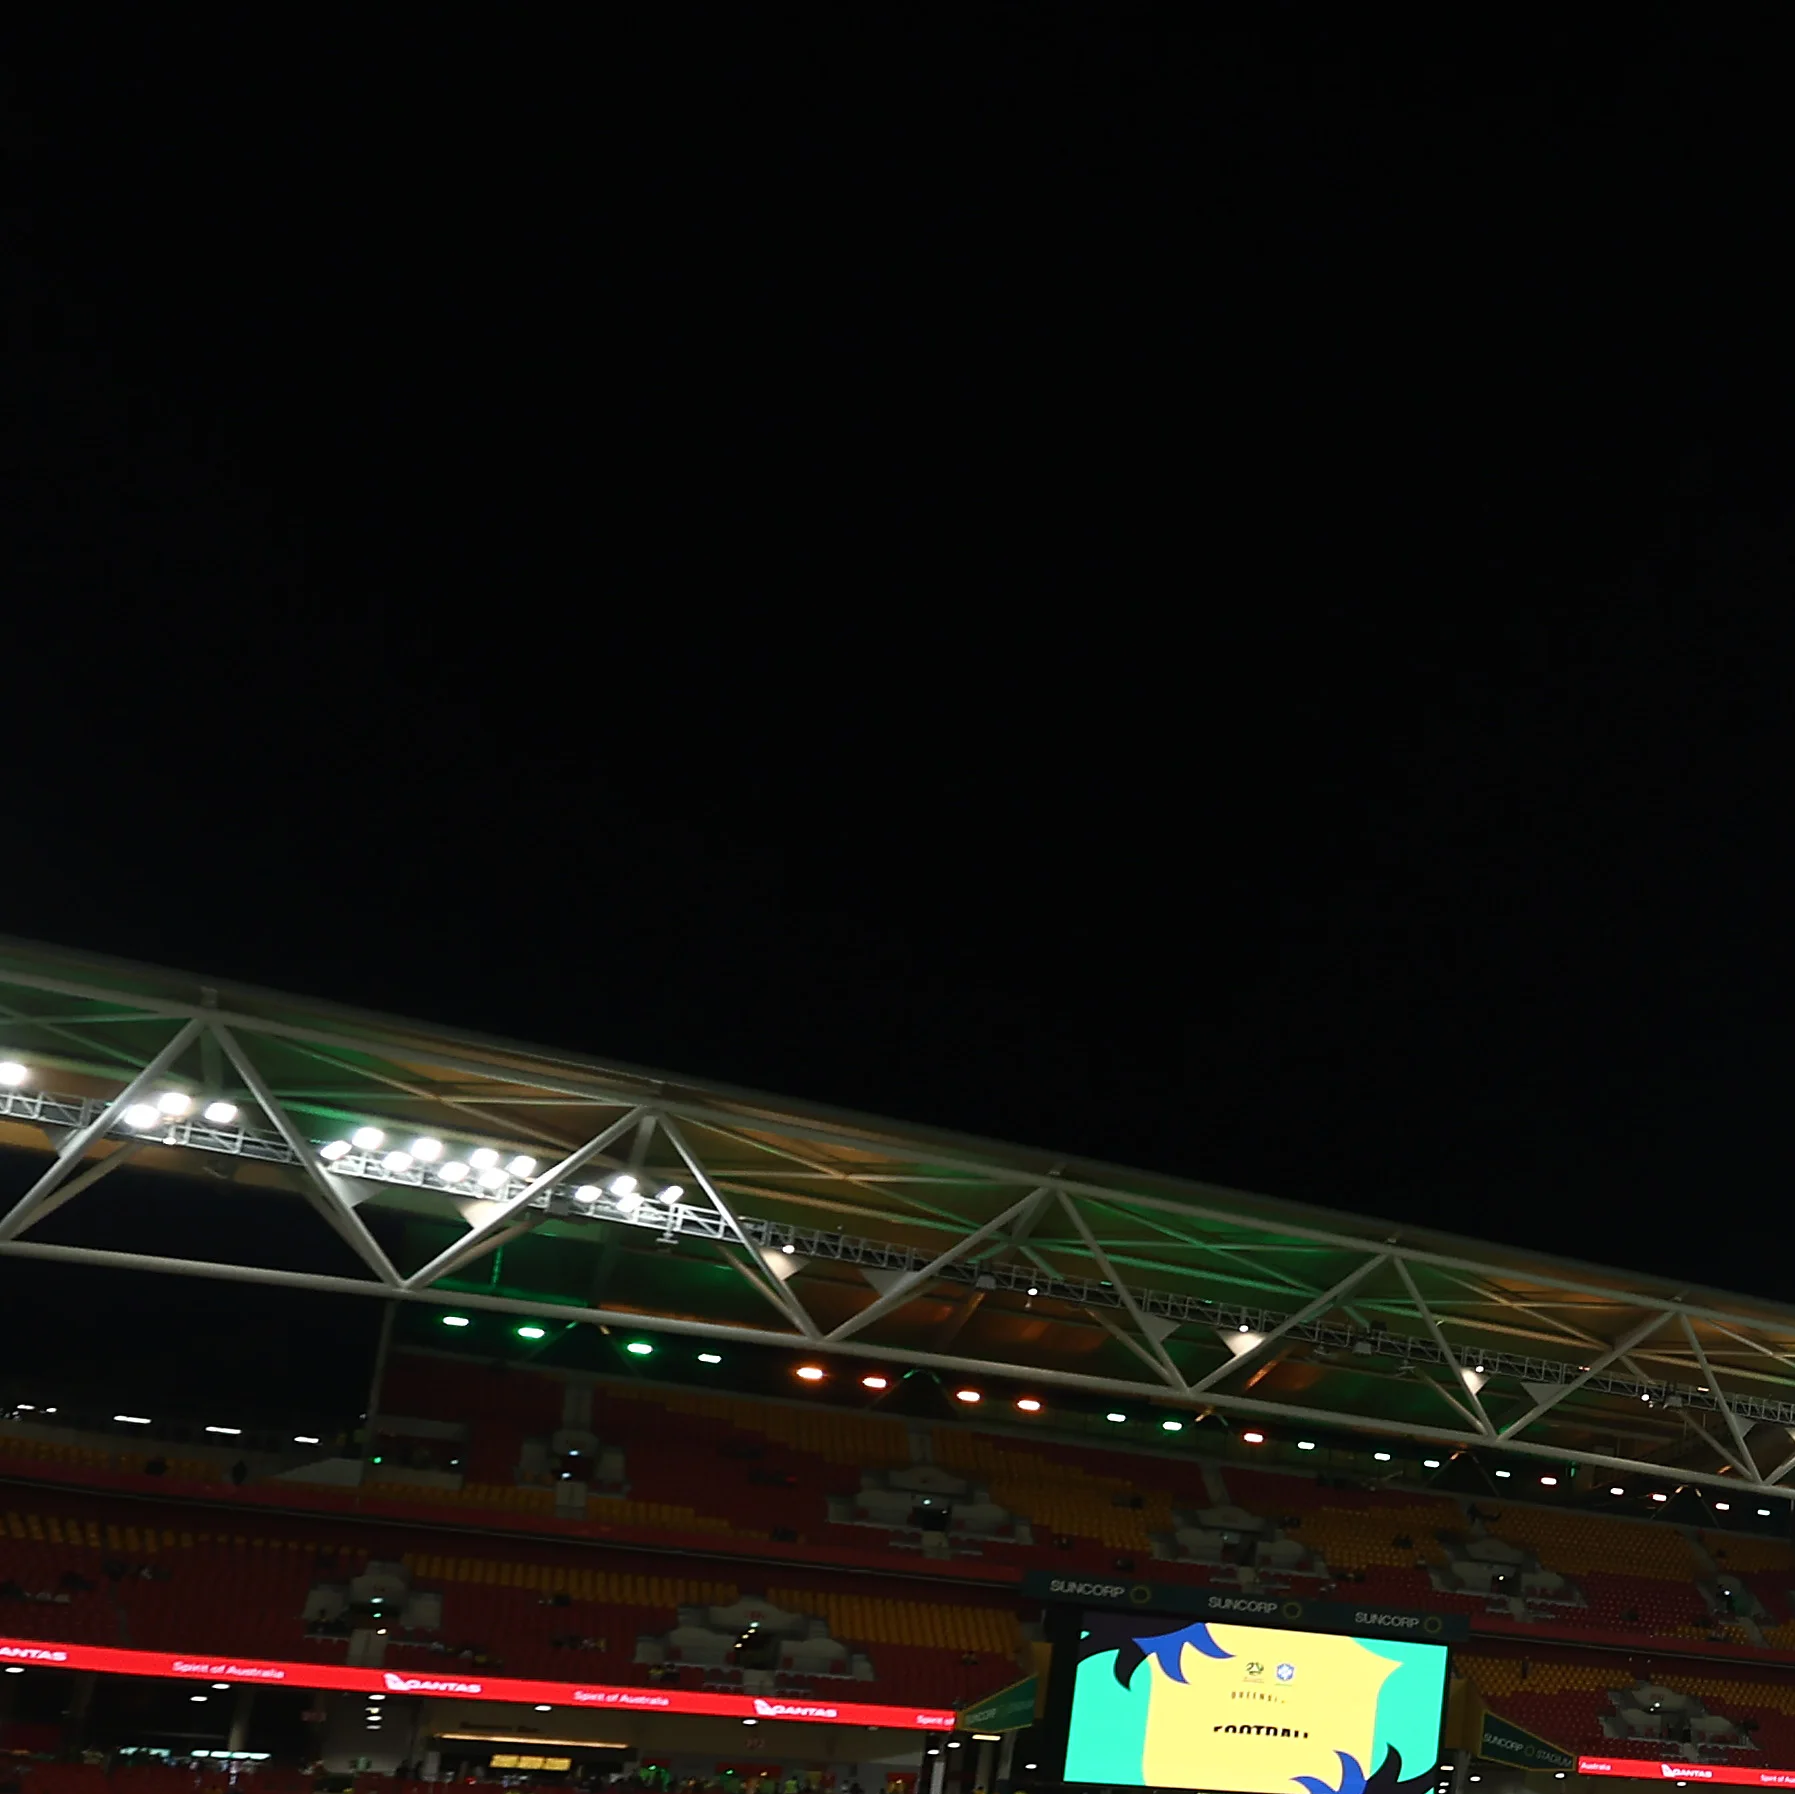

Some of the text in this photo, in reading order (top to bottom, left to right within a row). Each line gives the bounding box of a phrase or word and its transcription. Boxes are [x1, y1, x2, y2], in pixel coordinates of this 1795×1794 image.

[1050, 1579, 1125, 1598] SUNCORP
[1208, 1597, 1278, 1613] SUNCORP
[1355, 1612, 1420, 1628] SUNCORP
[0, 1647, 67, 1661] ANTAS
[405, 1680, 482, 1693] QANTAS
[773, 1704, 837, 1718] QANTAS
[1674, 1768, 1713, 1779] QANTAS
